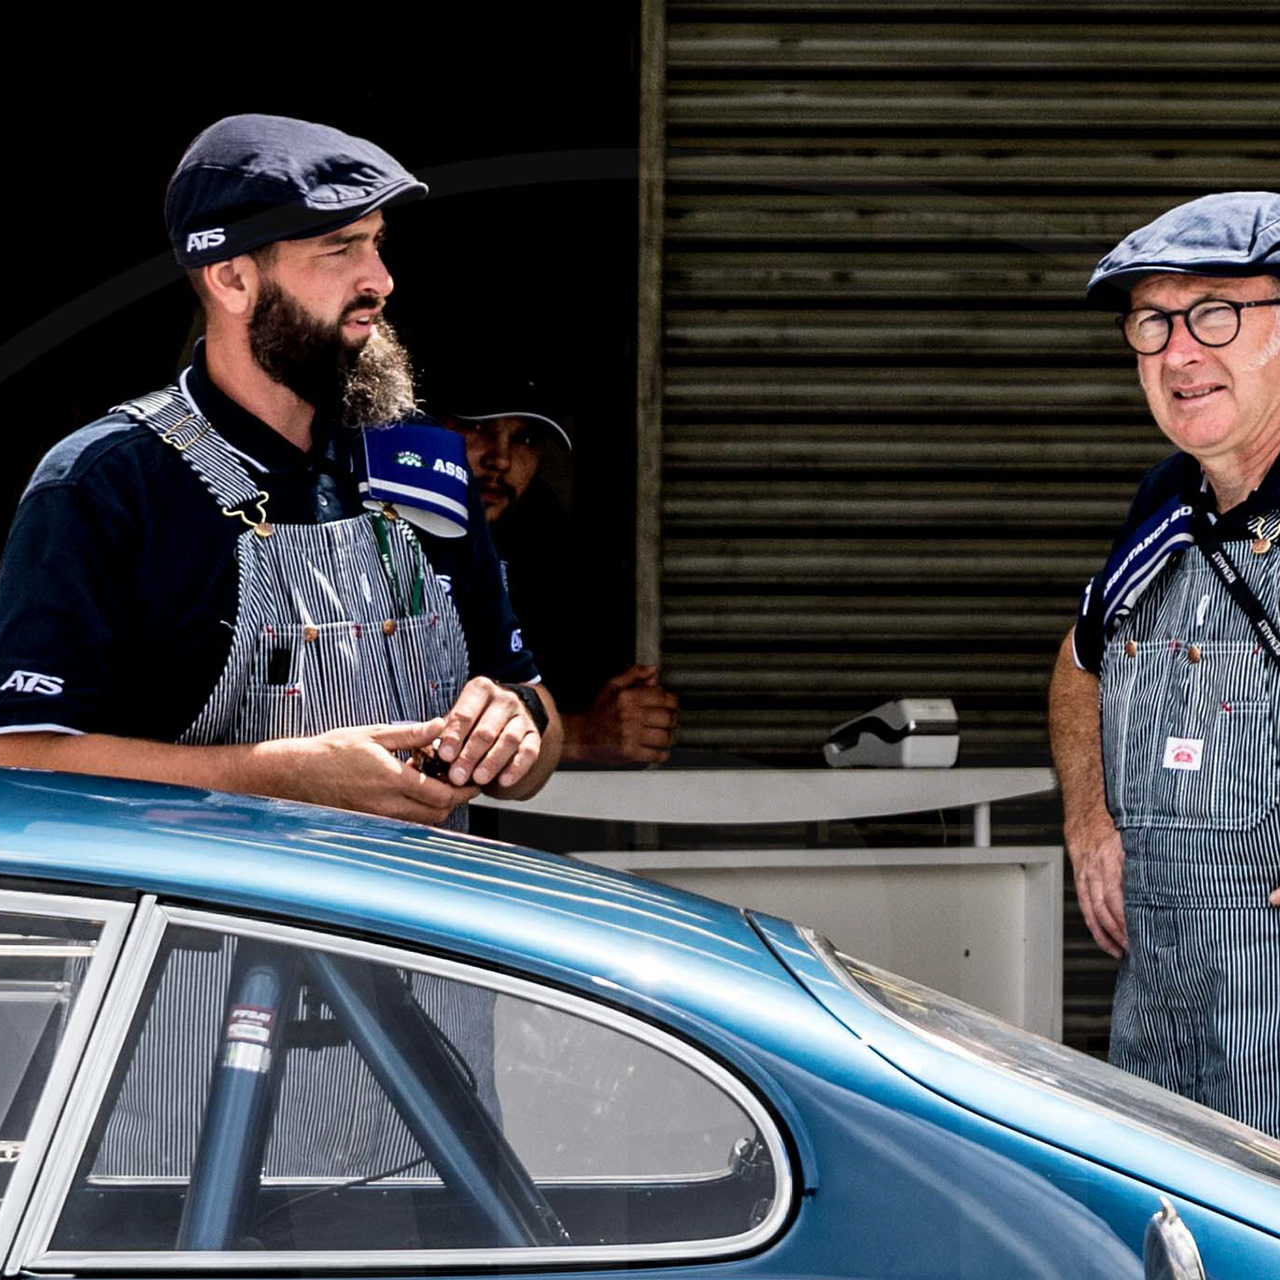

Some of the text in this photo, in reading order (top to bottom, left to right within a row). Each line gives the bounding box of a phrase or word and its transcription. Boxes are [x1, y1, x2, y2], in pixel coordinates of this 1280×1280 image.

[186, 227, 226, 252] ATS
[1211, 551, 1237, 584] RENAULT
[0, 670, 65, 695] ATS
